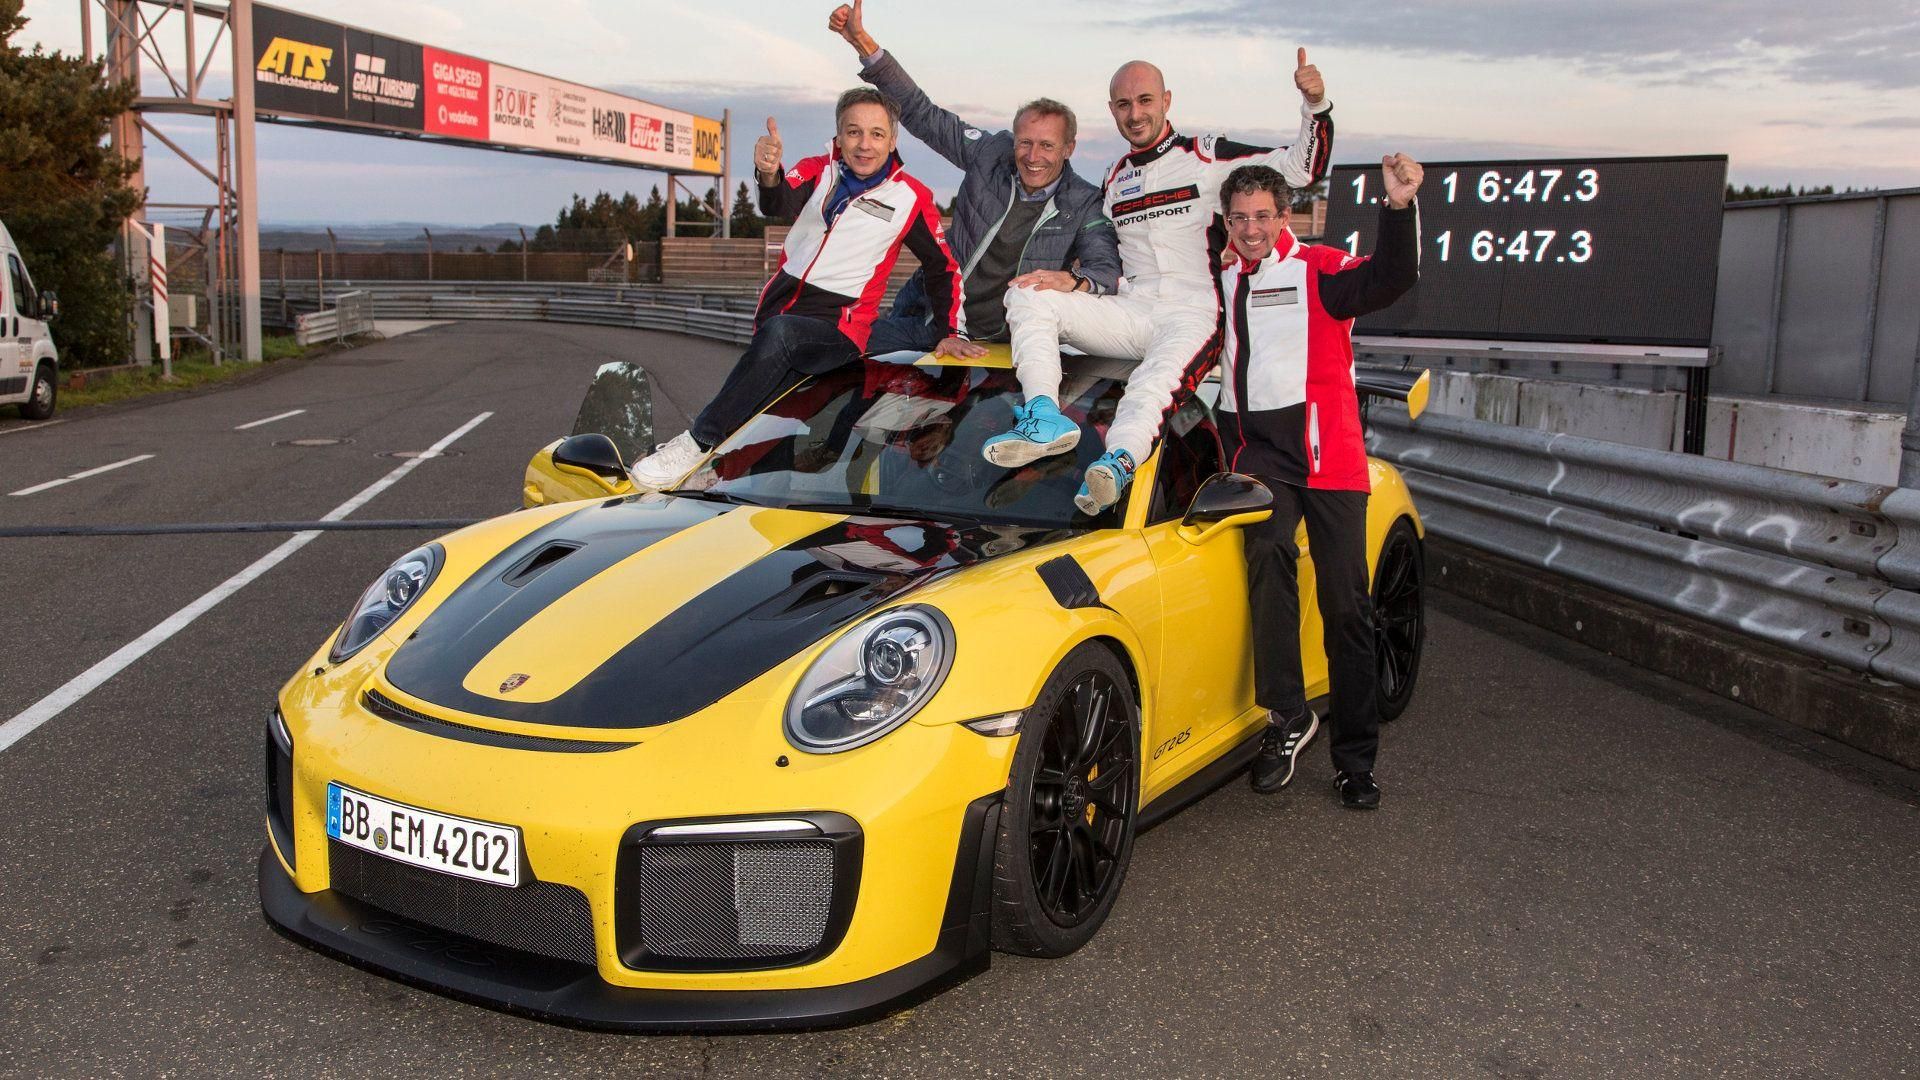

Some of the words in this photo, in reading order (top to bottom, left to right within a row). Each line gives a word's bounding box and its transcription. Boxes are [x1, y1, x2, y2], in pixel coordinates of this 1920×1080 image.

[257, 36, 333, 81] ATS
[353, 72, 379, 94] GRAN
[380, 76, 417, 101] TURISMO
[432, 62, 455, 83] GIGA
[455, 66, 482, 88] SPEED
[448, 110, 479, 126] vodafone
[494, 87, 537, 118] ROWE
[494, 113, 521, 126] MOTOR
[523, 118, 535, 129] OIL
[592, 107, 614, 138] H&R
[632, 127, 660, 149] auto
[695, 129, 719, 161] ADAC
[1442, 171, 1458, 203] 1
[1477, 168, 1599, 204] 6:47.3
[1436, 230, 1452, 262] 1
[1470, 229, 1594, 263] 6:47.3
[342, 796, 370, 841] BB
[391, 810, 425, 858] EM
[433, 823, 510, 876] 4202
